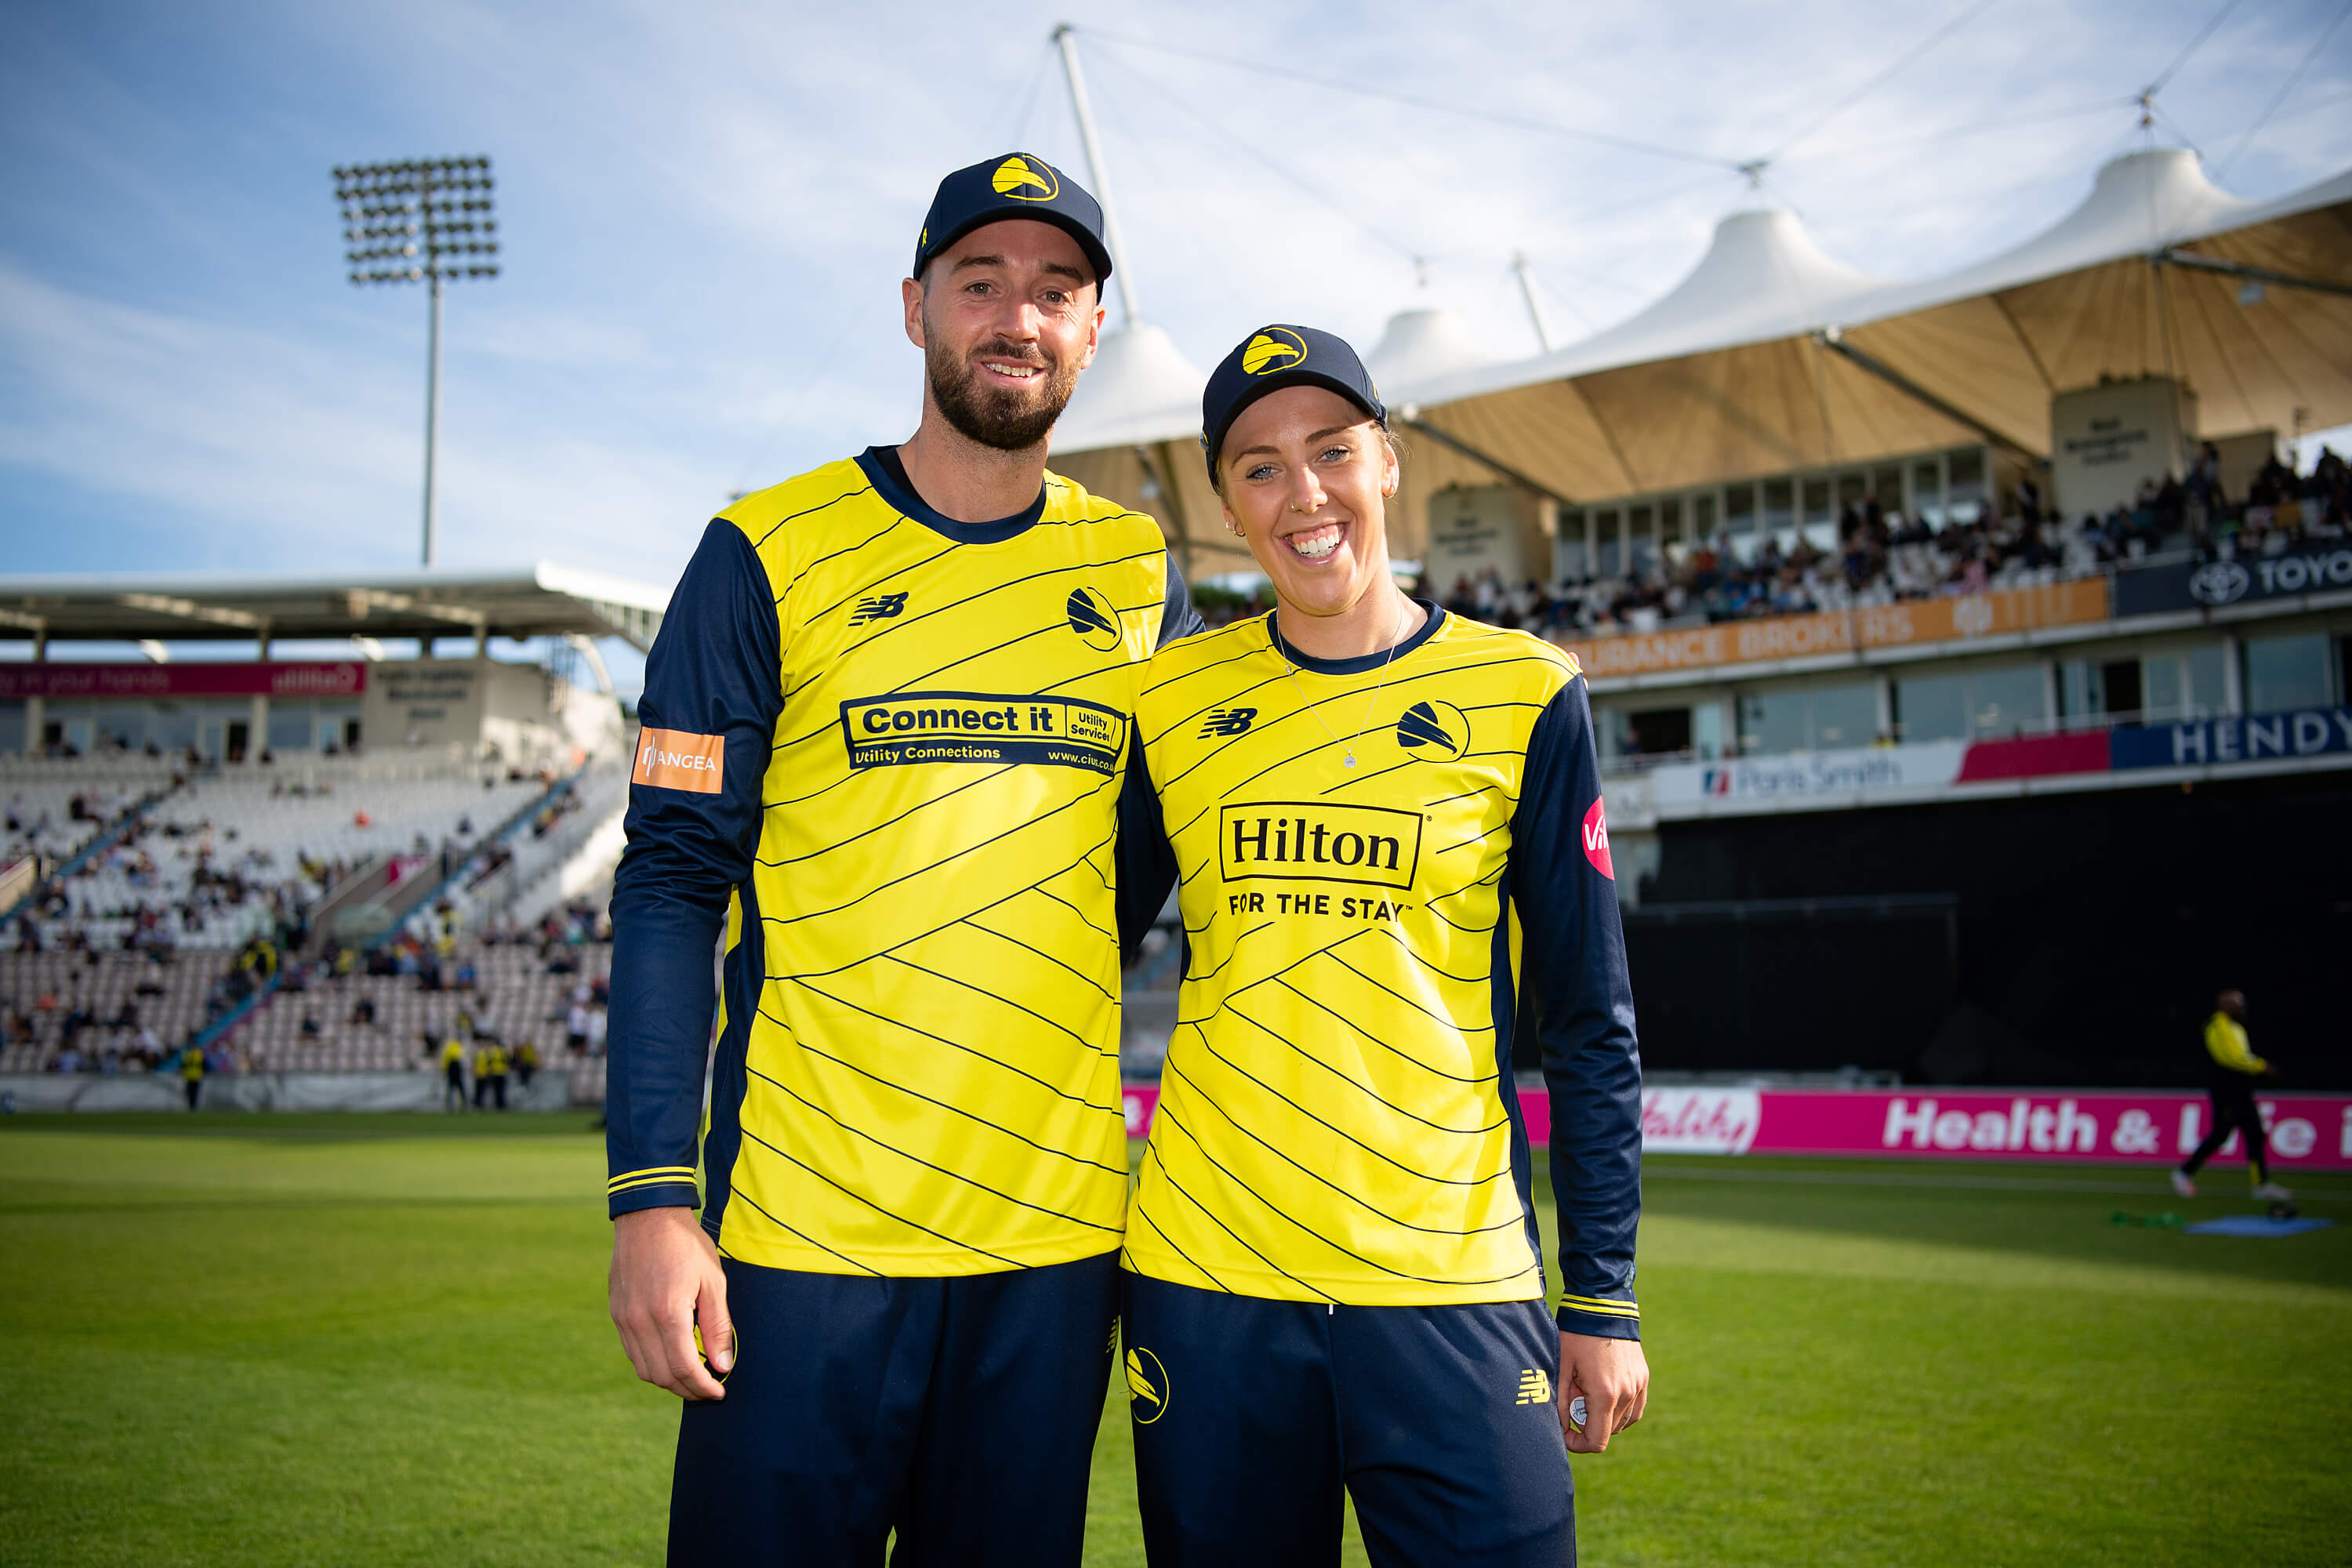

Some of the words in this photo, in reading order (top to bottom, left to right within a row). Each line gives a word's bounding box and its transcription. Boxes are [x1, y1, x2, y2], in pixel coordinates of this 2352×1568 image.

[862, 706, 1018, 734] Connect
[1029, 706, 1054, 731] it
[1079, 712, 1107, 731] Utility
[855, 748, 901, 764] Utility
[906, 746, 1001, 760] Connections
[1232, 818, 1400, 871] Hilton
[1229, 892, 1265, 916] FOR
[1276, 894, 1330, 915] THE
[1341, 898, 1404, 923] STAY
[1882, 1098, 2099, 1152] Health
[2111, 1108, 2161, 1154] &
